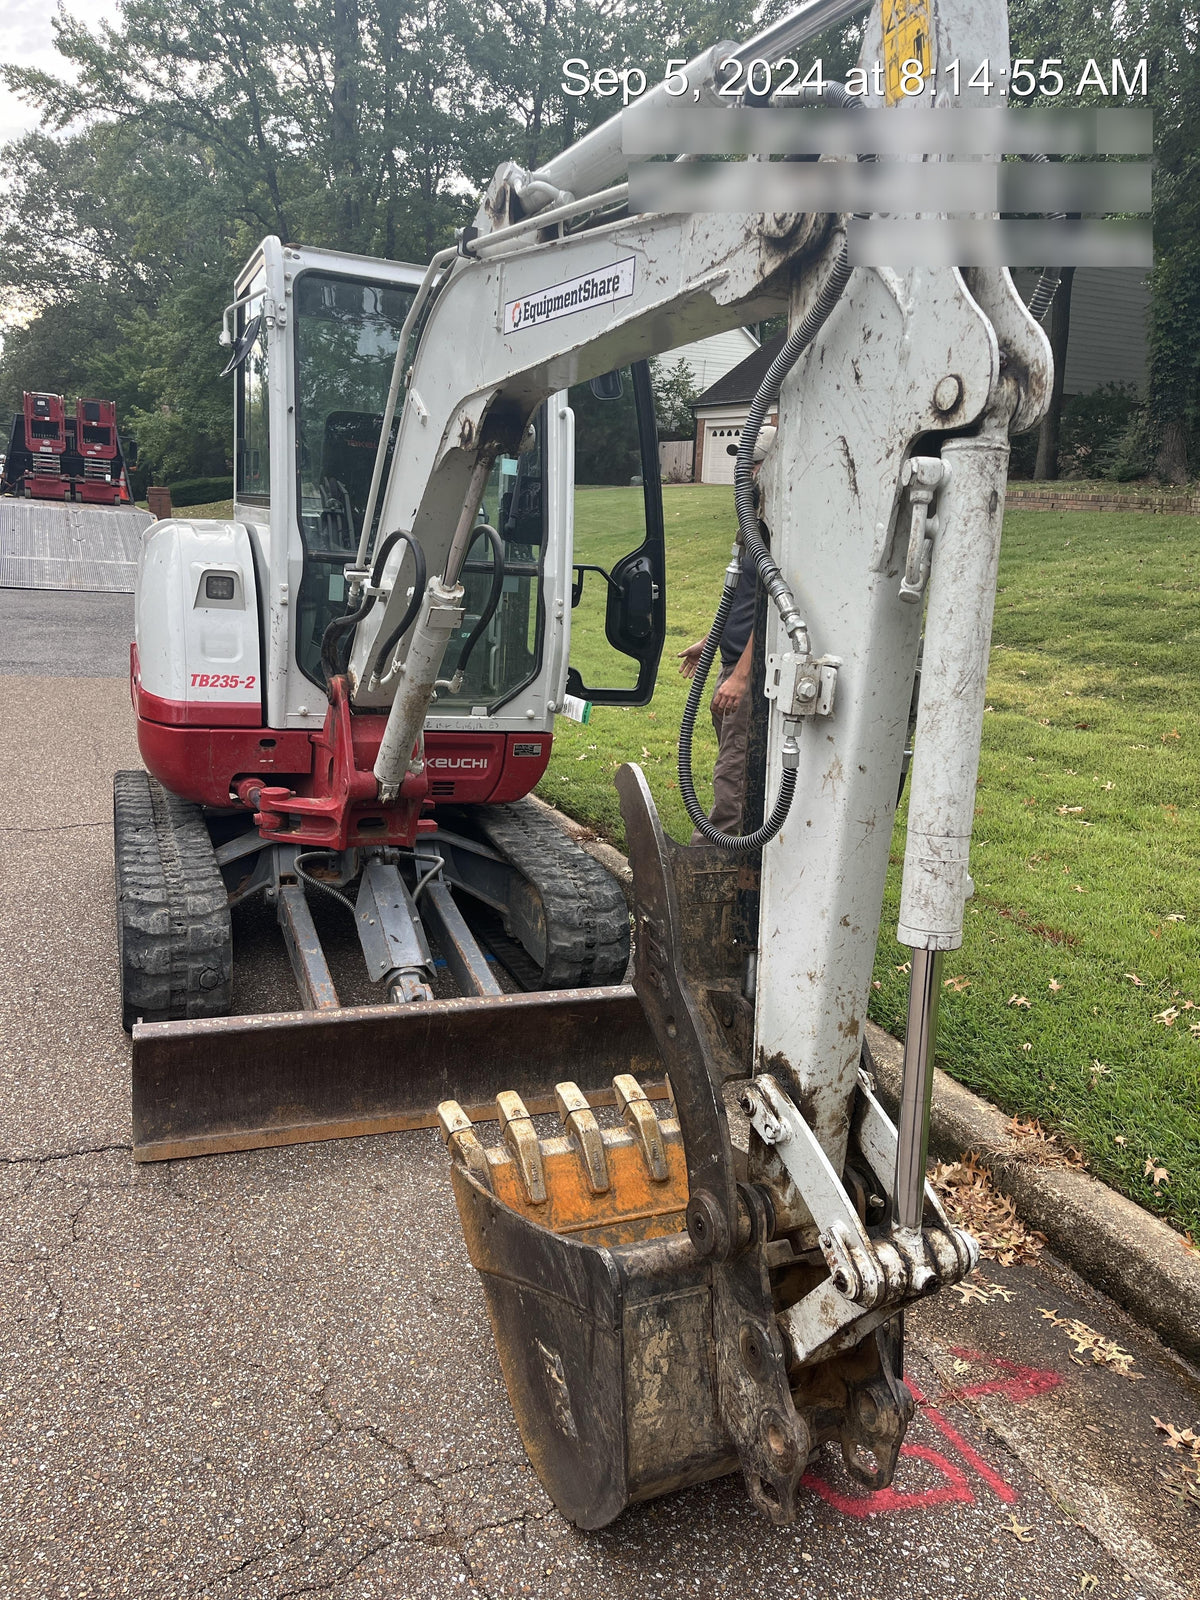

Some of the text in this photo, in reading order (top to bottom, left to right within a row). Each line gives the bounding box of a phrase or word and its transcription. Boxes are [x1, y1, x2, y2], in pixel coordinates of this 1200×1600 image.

[523, 274, 620, 323] EquipmentShare
[190, 674, 256, 689] TB235-2
[425, 758, 488, 769] KEUCHI
